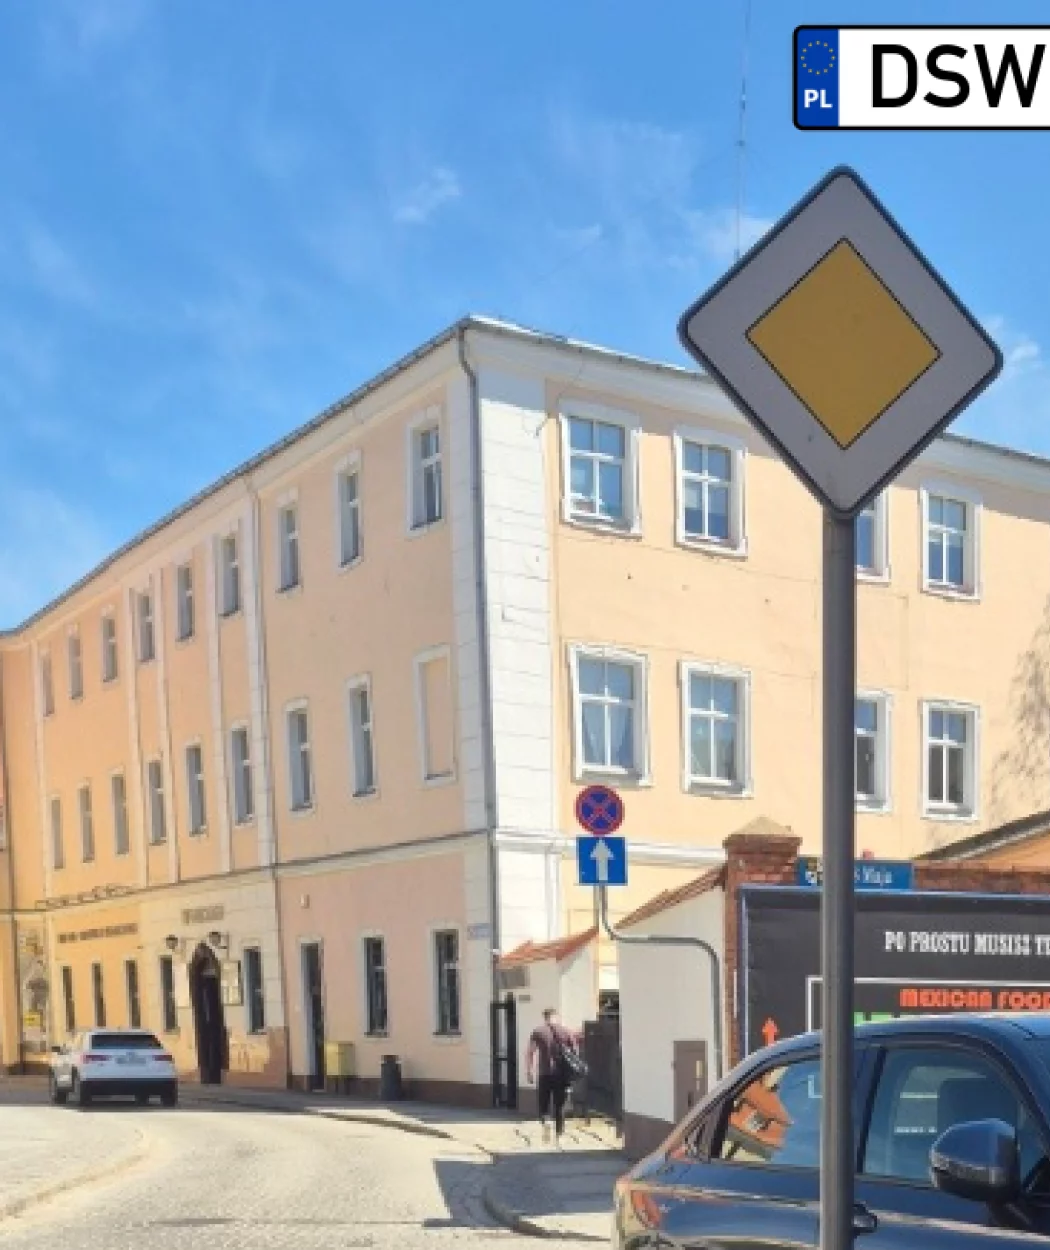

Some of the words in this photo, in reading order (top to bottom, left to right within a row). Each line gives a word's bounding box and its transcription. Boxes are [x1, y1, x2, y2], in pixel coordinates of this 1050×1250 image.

[885, 931, 906, 951] PO
[908, 931, 970, 954] PROSTU
[974, 933, 1030, 955] MUSISZ
[899, 988, 992, 1008] MEXICAN
